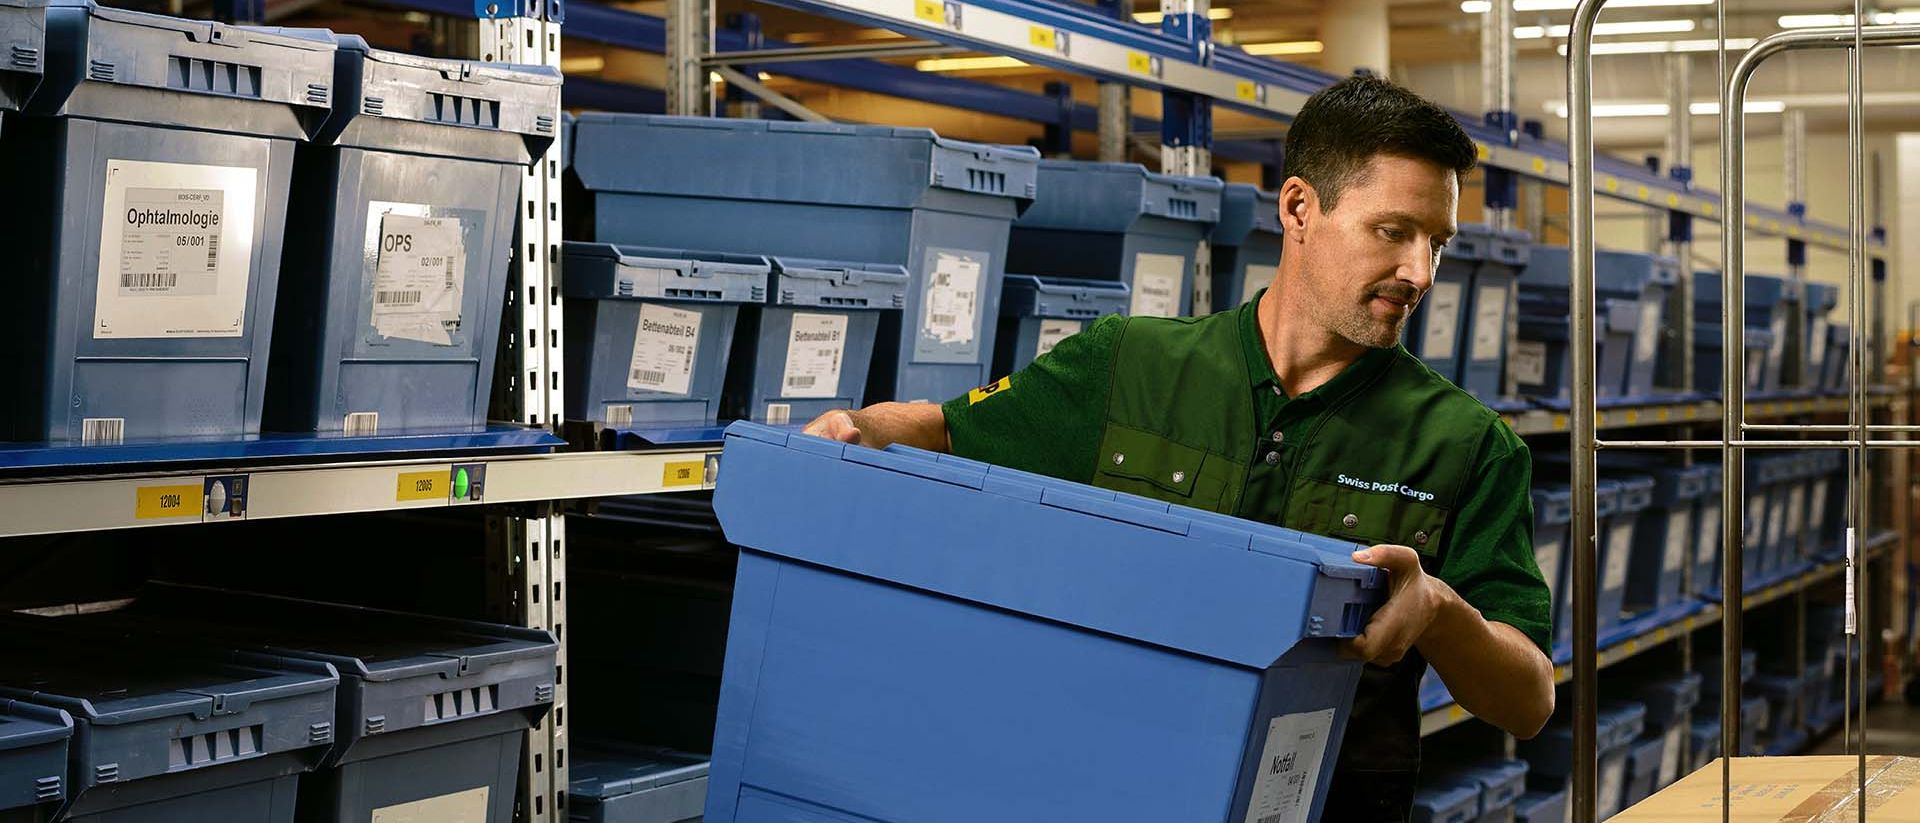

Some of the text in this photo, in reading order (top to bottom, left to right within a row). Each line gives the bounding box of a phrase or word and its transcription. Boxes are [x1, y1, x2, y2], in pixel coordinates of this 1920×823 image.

[127, 208, 219, 229] Ophtalmologie
[176, 235, 204, 246] 05/001
[384, 234, 412, 252] OPS
[421, 257, 443, 267] 02/001
[642, 318, 695, 338] Bettenabteil B4
[795, 330, 832, 342] Bettenabteil
[416, 479, 432, 493] 12005
[1337, 474, 1434, 501] Swiss Post Cargo
[160, 494, 181, 508] 12004
[1269, 751, 1297, 776] Notfall
